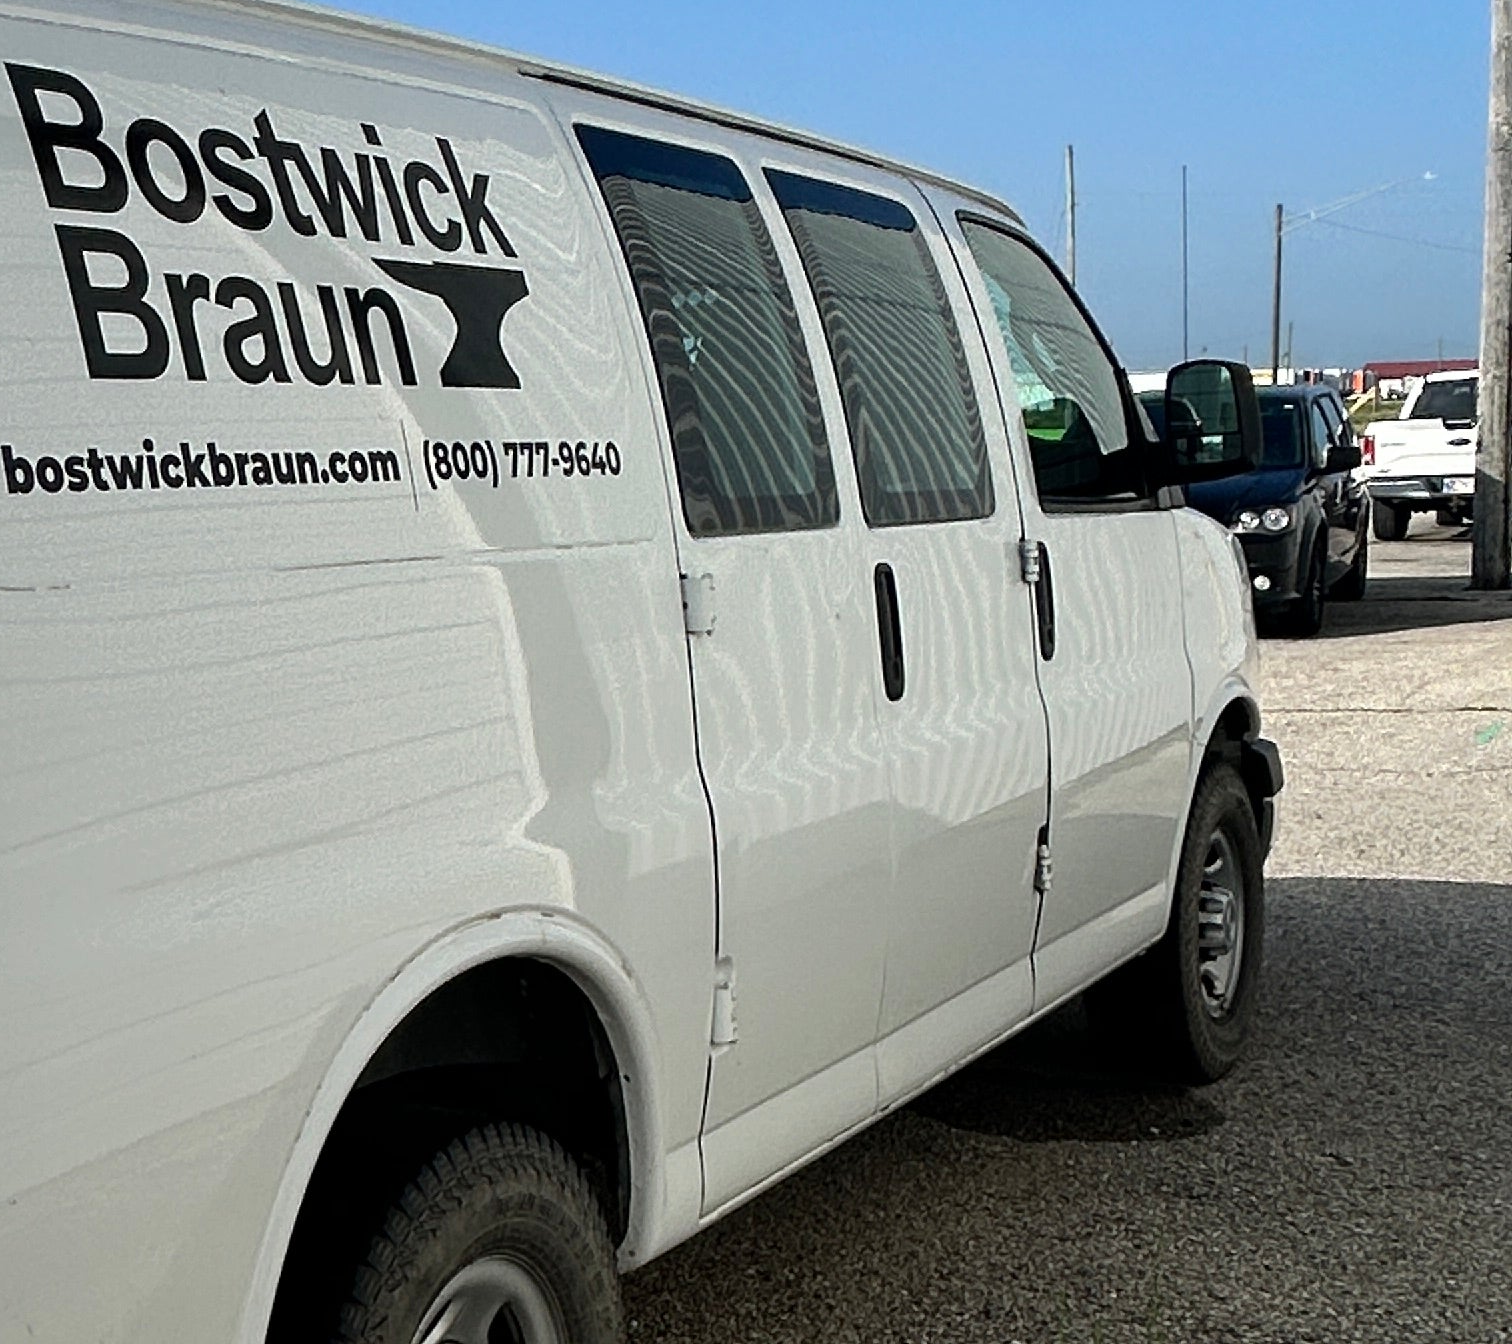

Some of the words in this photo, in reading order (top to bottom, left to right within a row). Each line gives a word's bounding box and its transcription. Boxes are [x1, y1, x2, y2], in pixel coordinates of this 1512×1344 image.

[3, 61, 517, 257] Bostwick
[55, 223, 418, 386] Braun
[1, 438, 401, 493] bostwickbraun.com
[423, 440, 499, 488] (800)
[503, 441, 622, 478] 777-9640
